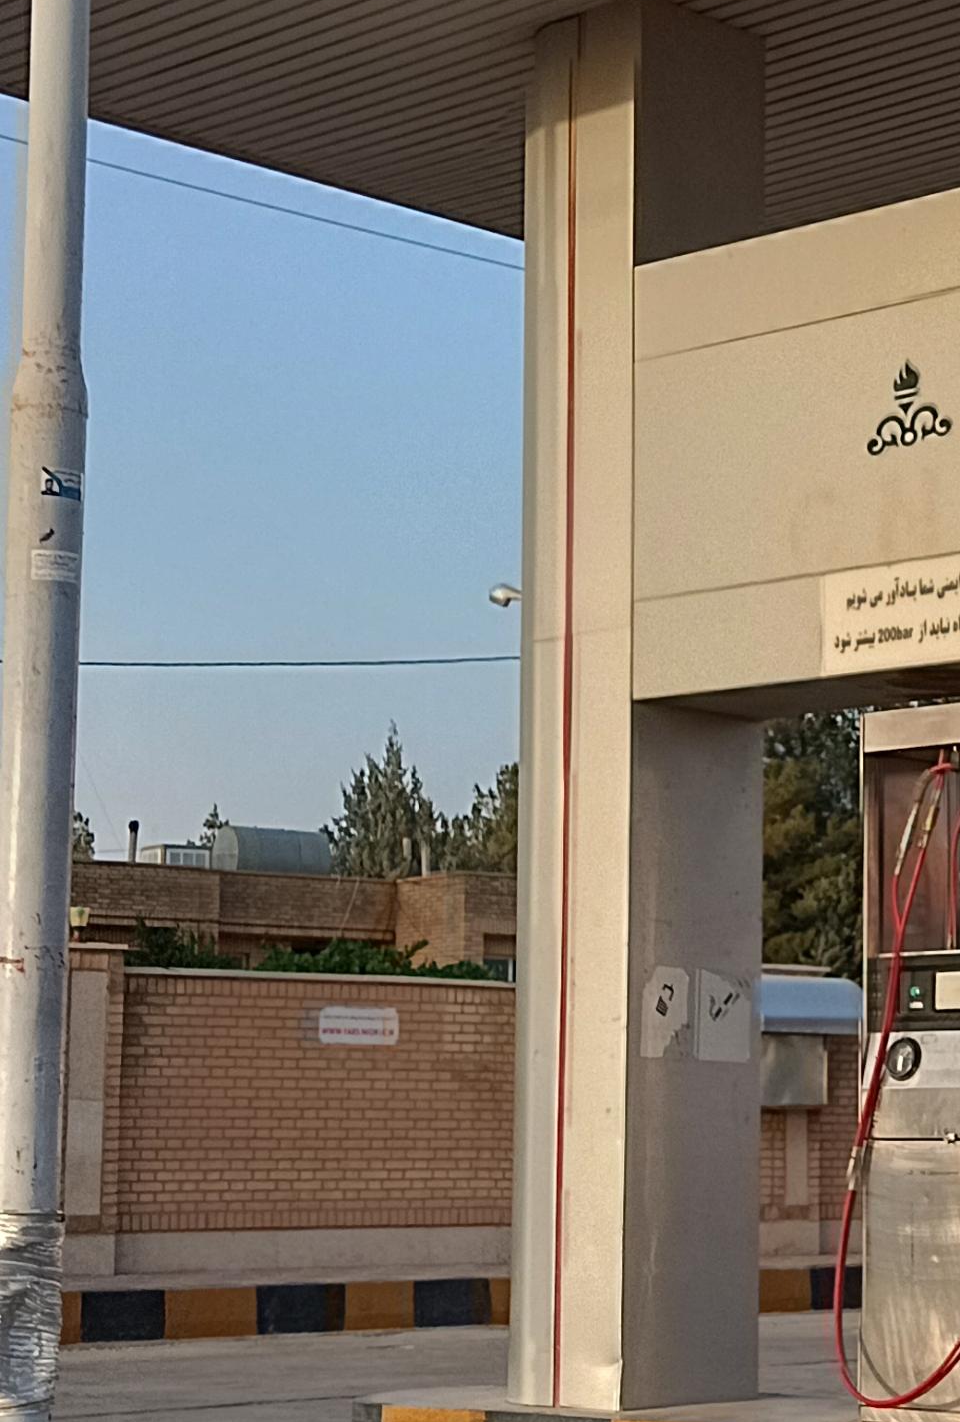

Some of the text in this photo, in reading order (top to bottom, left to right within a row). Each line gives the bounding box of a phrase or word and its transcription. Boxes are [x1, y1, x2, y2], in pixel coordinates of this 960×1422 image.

[919, 578, 934, 595] شما
[846, 587, 867, 611] شویم
[869, 590, 883, 608] می
[877, 627, 913, 644] 200bar
[918, 618, 927, 643] از
[929, 617, 950, 640] نباید
[834, 632, 851, 654] شود
[853, 629, 876, 652] بیشتر
